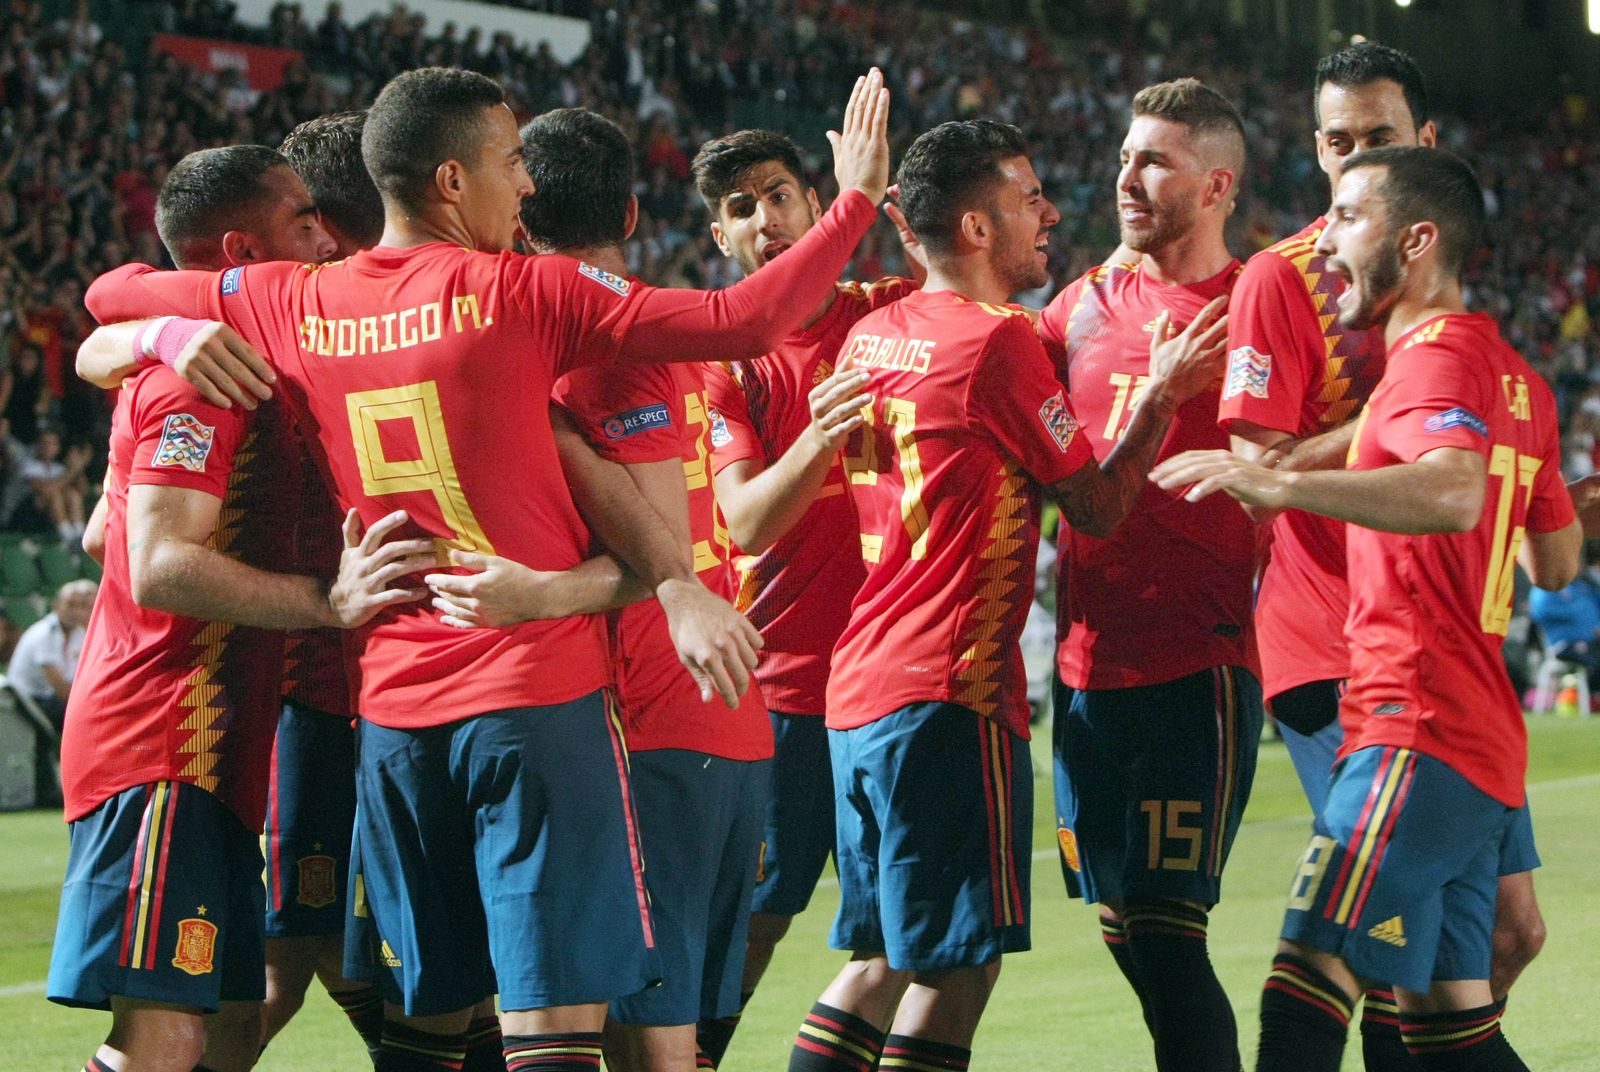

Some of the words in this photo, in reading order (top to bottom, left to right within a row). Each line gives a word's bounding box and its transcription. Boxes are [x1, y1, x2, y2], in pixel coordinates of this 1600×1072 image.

[452, 294, 493, 333] M.
[624, 410, 668, 429] RESPECT
[345, 379, 497, 567] 9
[1141, 800, 1203, 871] 15
